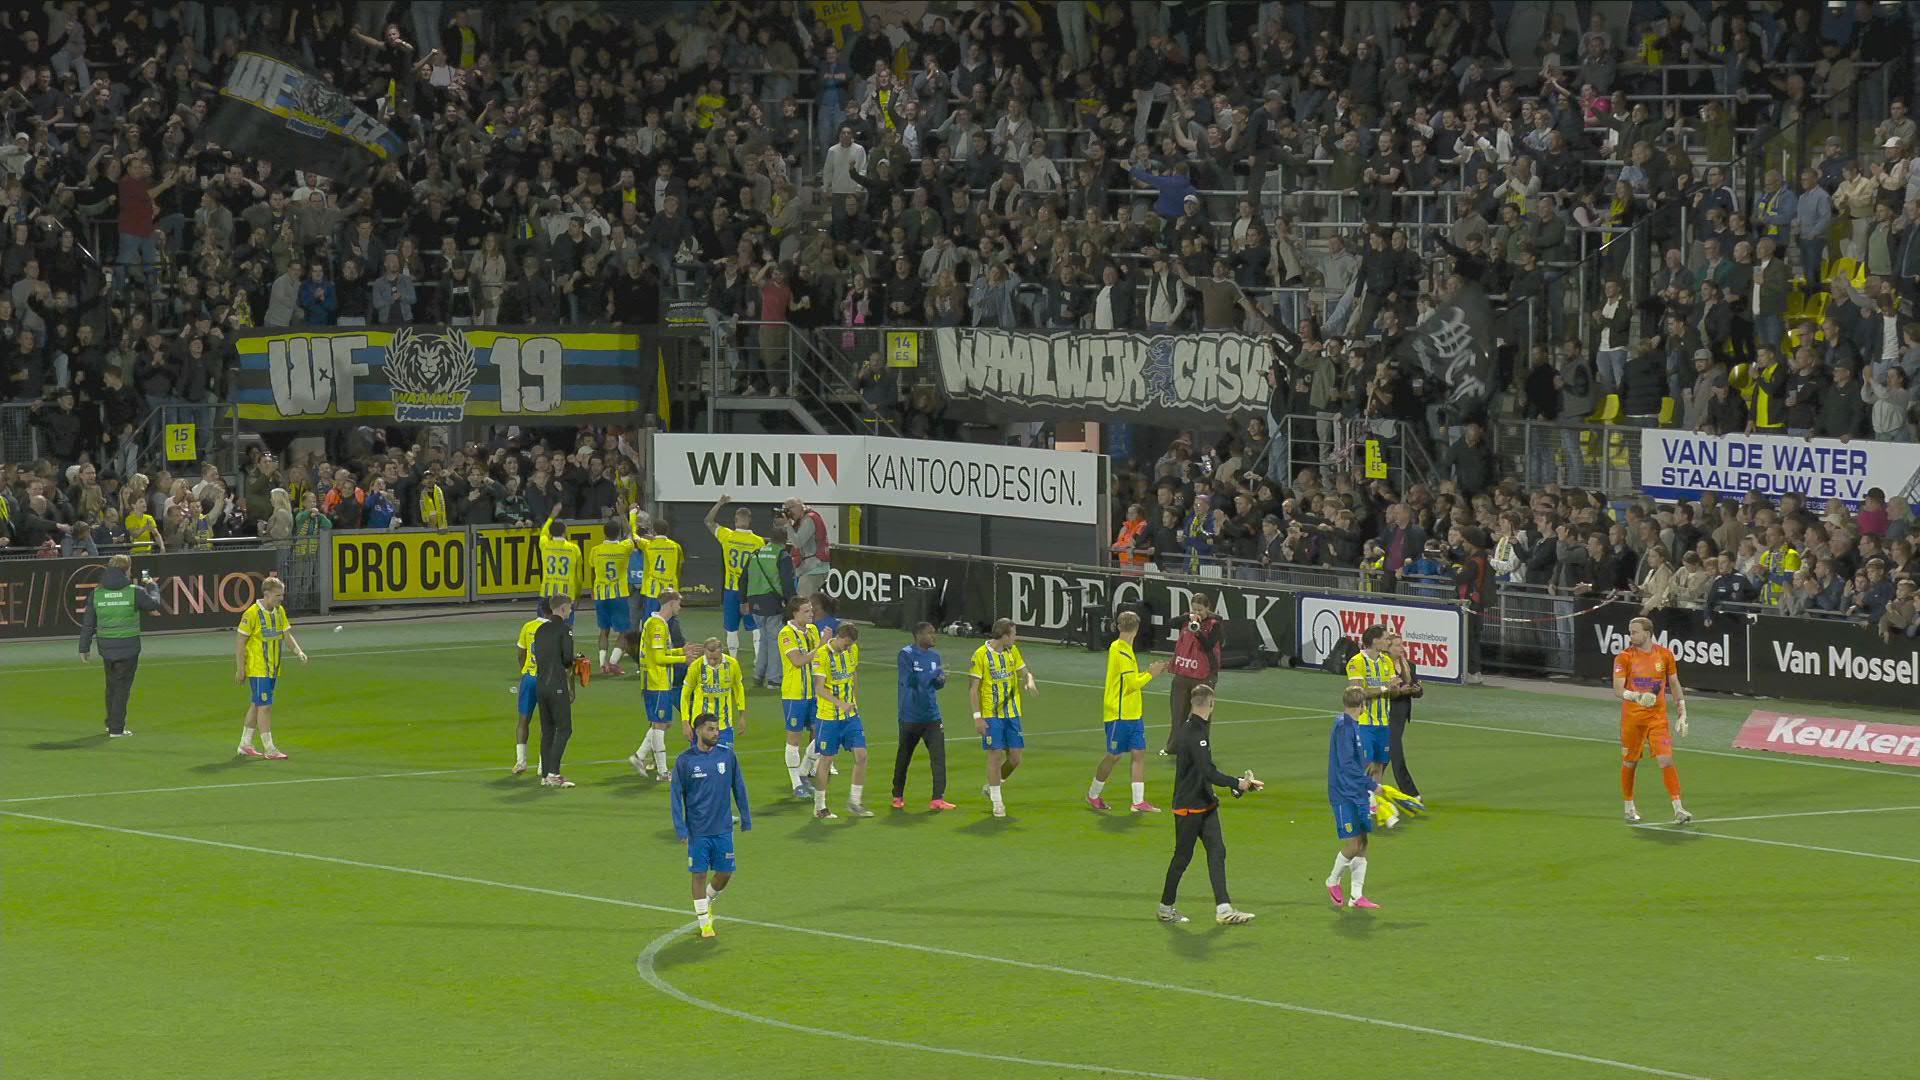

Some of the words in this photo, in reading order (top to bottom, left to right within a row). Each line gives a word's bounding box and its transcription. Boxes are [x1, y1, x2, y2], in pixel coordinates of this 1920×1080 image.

[895, 336, 912, 348] 14
[267, 334, 370, 417] WF
[489, 336, 564, 413] 19
[937, 328, 1148, 403] WAALWIJK
[174, 429, 188, 441] 15
[686, 451, 796, 488] WINI
[1662, 438, 1718, 466] VAN
[1728, 442, 1763, 470] DE
[1772, 444, 1868, 476] WATER
[867, 453, 1083, 507] KANTOORDESIGN.
[1661, 467, 1812, 497] STAALBOUW
[338, 540, 408, 593] PRO
[547, 555, 570, 576] 33
[605, 561, 617, 581] 5
[654, 554, 666, 573] 4
[728, 548, 753, 568] 30
[822, 568, 892, 602] OORE
[1772, 640, 1820, 676] Van
[1828, 645, 1919, 685] Mossel
